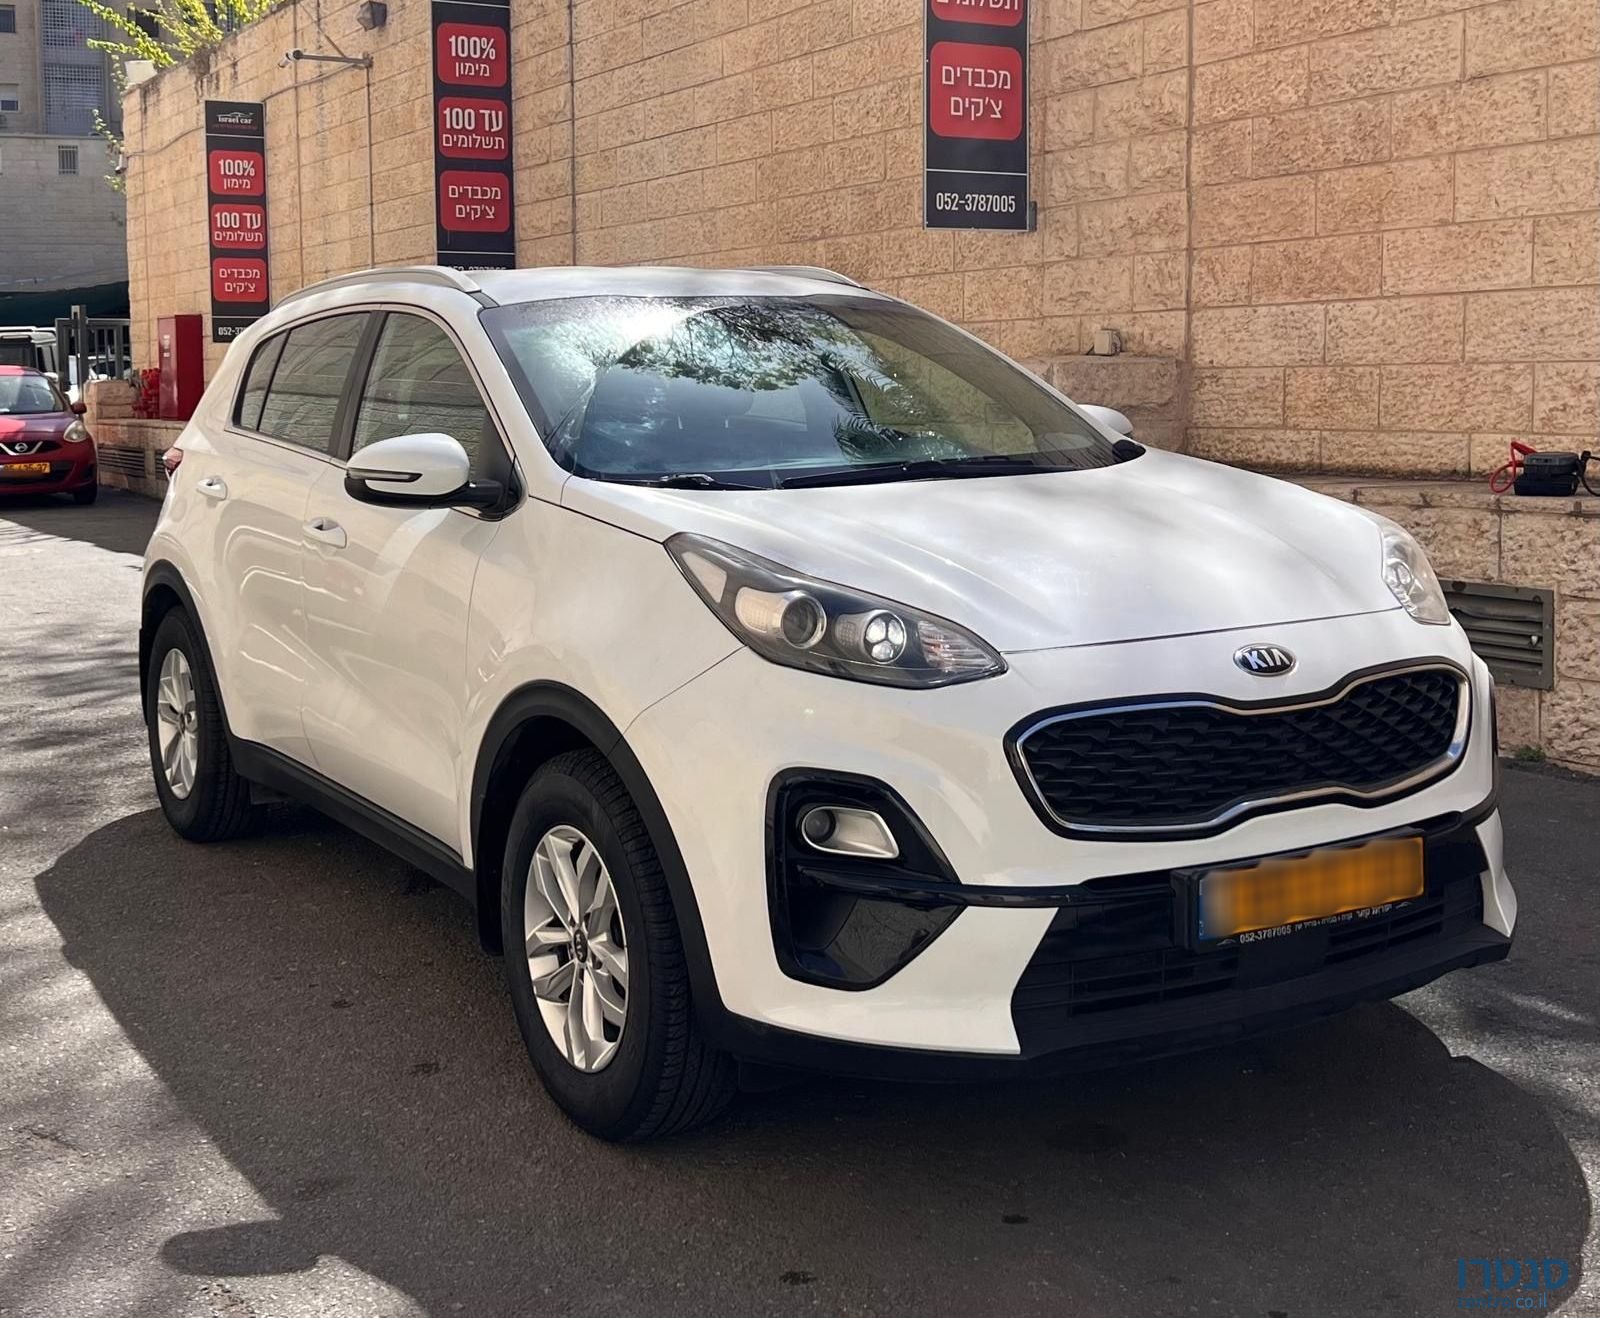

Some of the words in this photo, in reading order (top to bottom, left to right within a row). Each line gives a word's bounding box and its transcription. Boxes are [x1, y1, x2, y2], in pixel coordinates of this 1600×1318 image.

[448, 35, 497, 60] 100%
[455, 62, 490, 77] מימון
[942, 65, 1011, 90] מכבדים
[443, 107, 475, 130] 100
[479, 109, 503, 132] עד
[442, 133, 505, 150] תשלומים
[218, 158, 255, 177] 100%
[223, 178, 251, 190] מימון
[448, 185, 501, 200] מכבדים
[936, 192, 1016, 213] 052-3787005
[214, 212, 240, 229] 100
[242, 213, 262, 230] עד
[214, 231, 263, 242] תשלומים
[219, 268, 260, 279] מכבדים
[1242, 648, 1291, 669] KIA
[1239, 925, 1292, 944] 052-3787005
